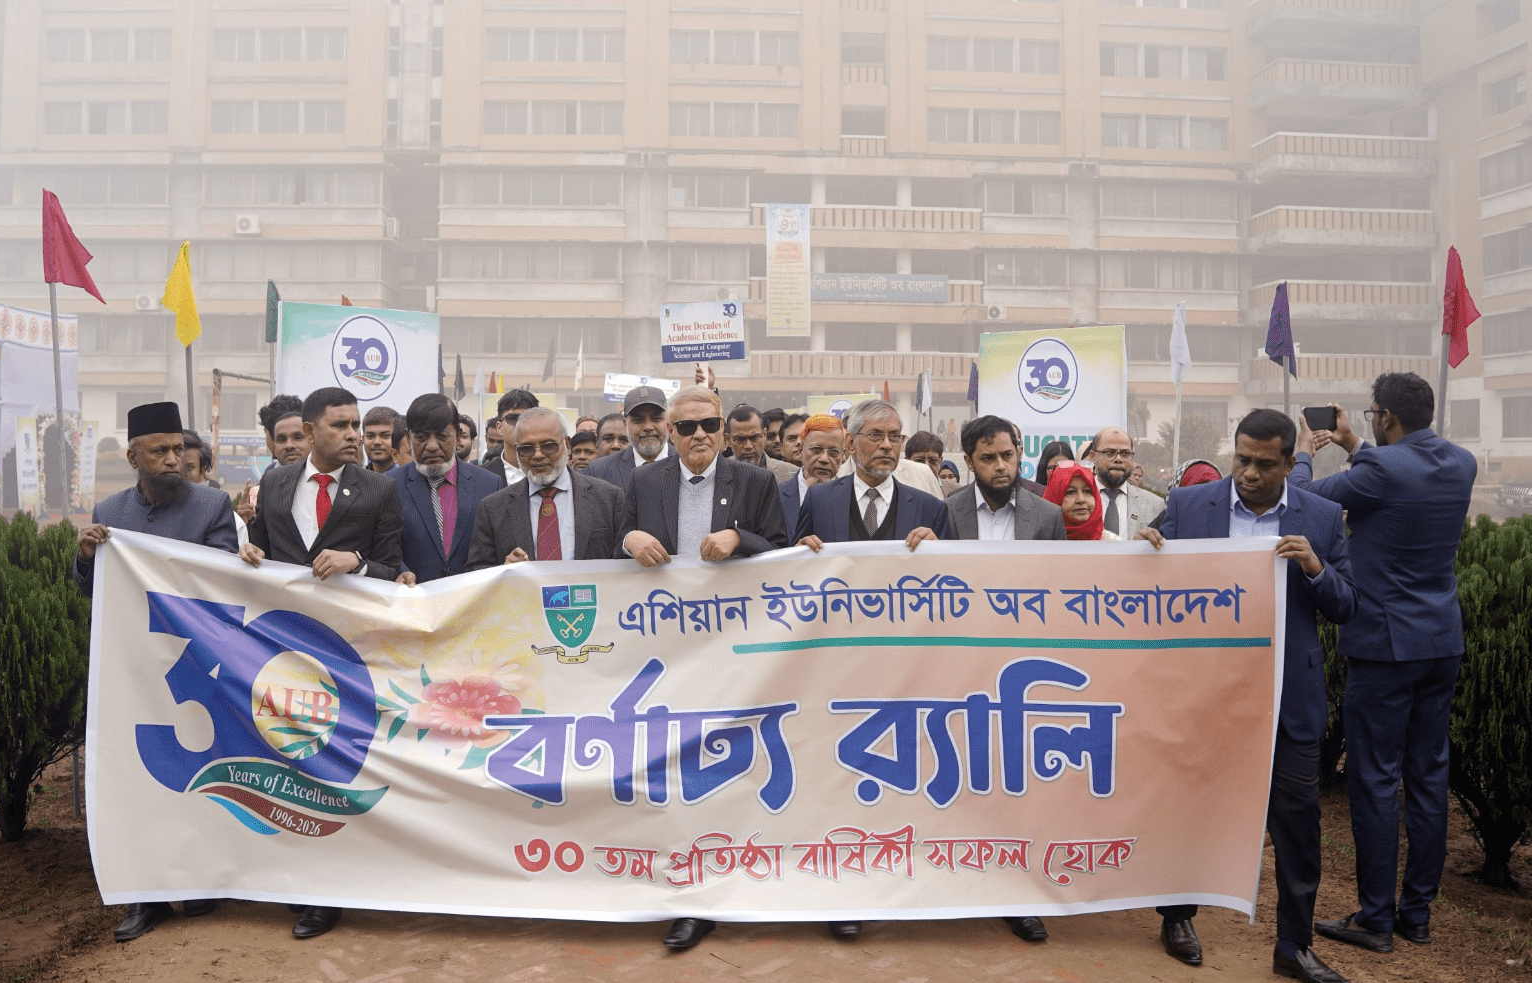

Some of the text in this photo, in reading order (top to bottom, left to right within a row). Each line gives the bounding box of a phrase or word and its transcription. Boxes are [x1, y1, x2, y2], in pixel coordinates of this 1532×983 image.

[672, 320, 731, 332] Three Decades of
[722, 303, 737, 317] 30
[667, 331, 738, 342] Academic Excellence
[671, 345, 699, 354] Department
[706, 344, 731, 352] Computer
[339, 337, 389, 378] 30
[702, 351, 731, 359] Engineering
[1025, 357, 1069, 393] 30
[1047, 371, 1062, 379] AUB
[618, 574, 1248, 637] এশিয়ান ইউনিভার্সিটি অব বাংলাদেশ
[135, 591, 376, 793] 30
[255, 686, 334, 724] AUB
[483, 658, 800, 813] বর্ণাঢ্য
[227, 765, 349, 808] Years of Excellence
[268, 806, 322, 836] 1996-2026
[513, 823, 1137, 887] ৩০ তম প্রতিষ্ঠা বার্ষিকী সফল হোক
